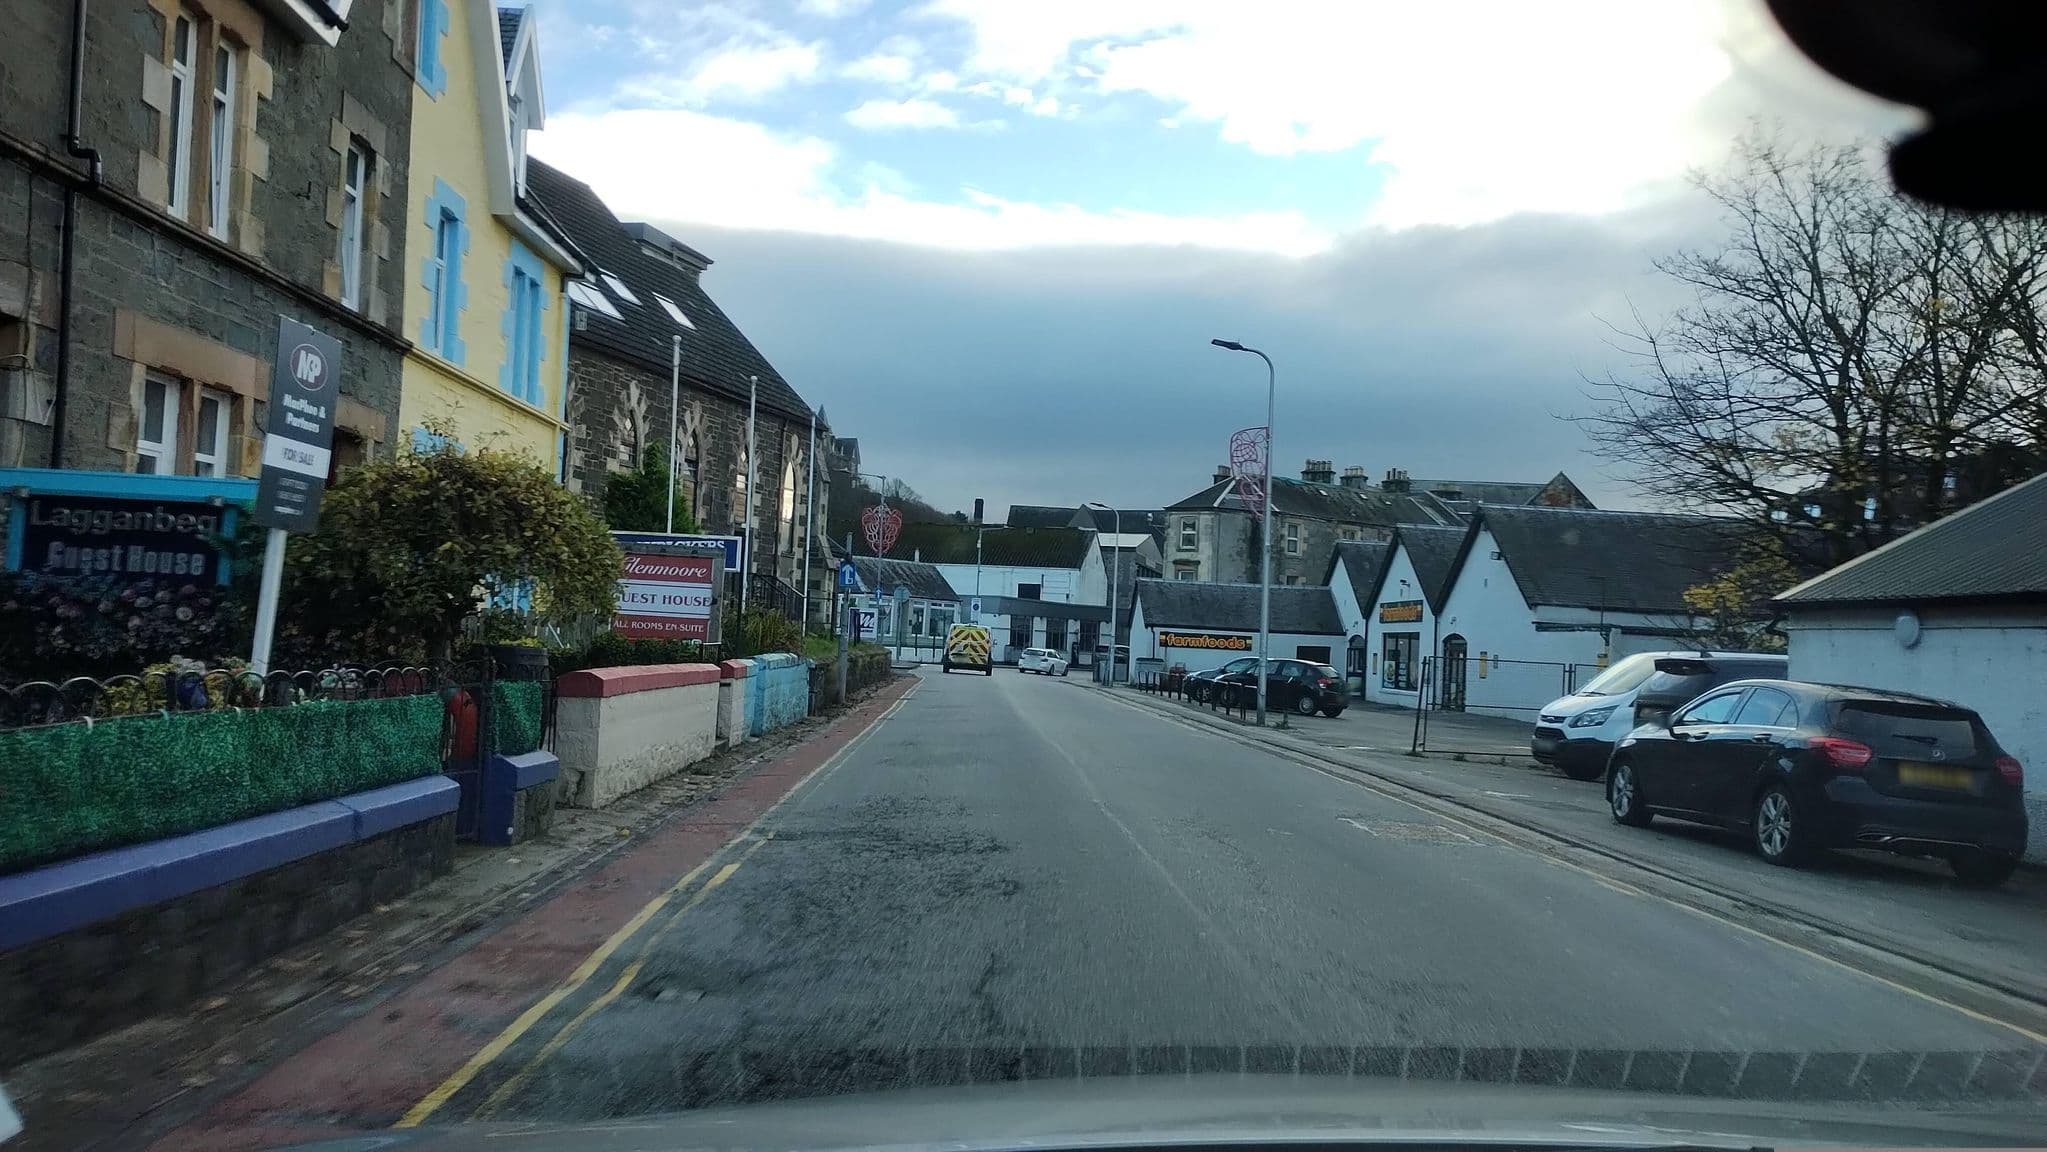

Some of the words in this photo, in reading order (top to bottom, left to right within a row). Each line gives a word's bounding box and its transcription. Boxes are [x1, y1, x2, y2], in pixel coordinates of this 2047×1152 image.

[283, 447, 297, 463] FOR
[298, 451, 315, 466] SALE
[30, 500, 218, 541] Lagganbeg
[48, 541, 124, 573] Guest
[126, 545, 206, 576] House
[618, 592, 657, 606] UEST
[662, 594, 713, 608] HOUSE
[631, 620, 664, 631] ROOMS
[1166, 633, 1246, 649] farmfoods
